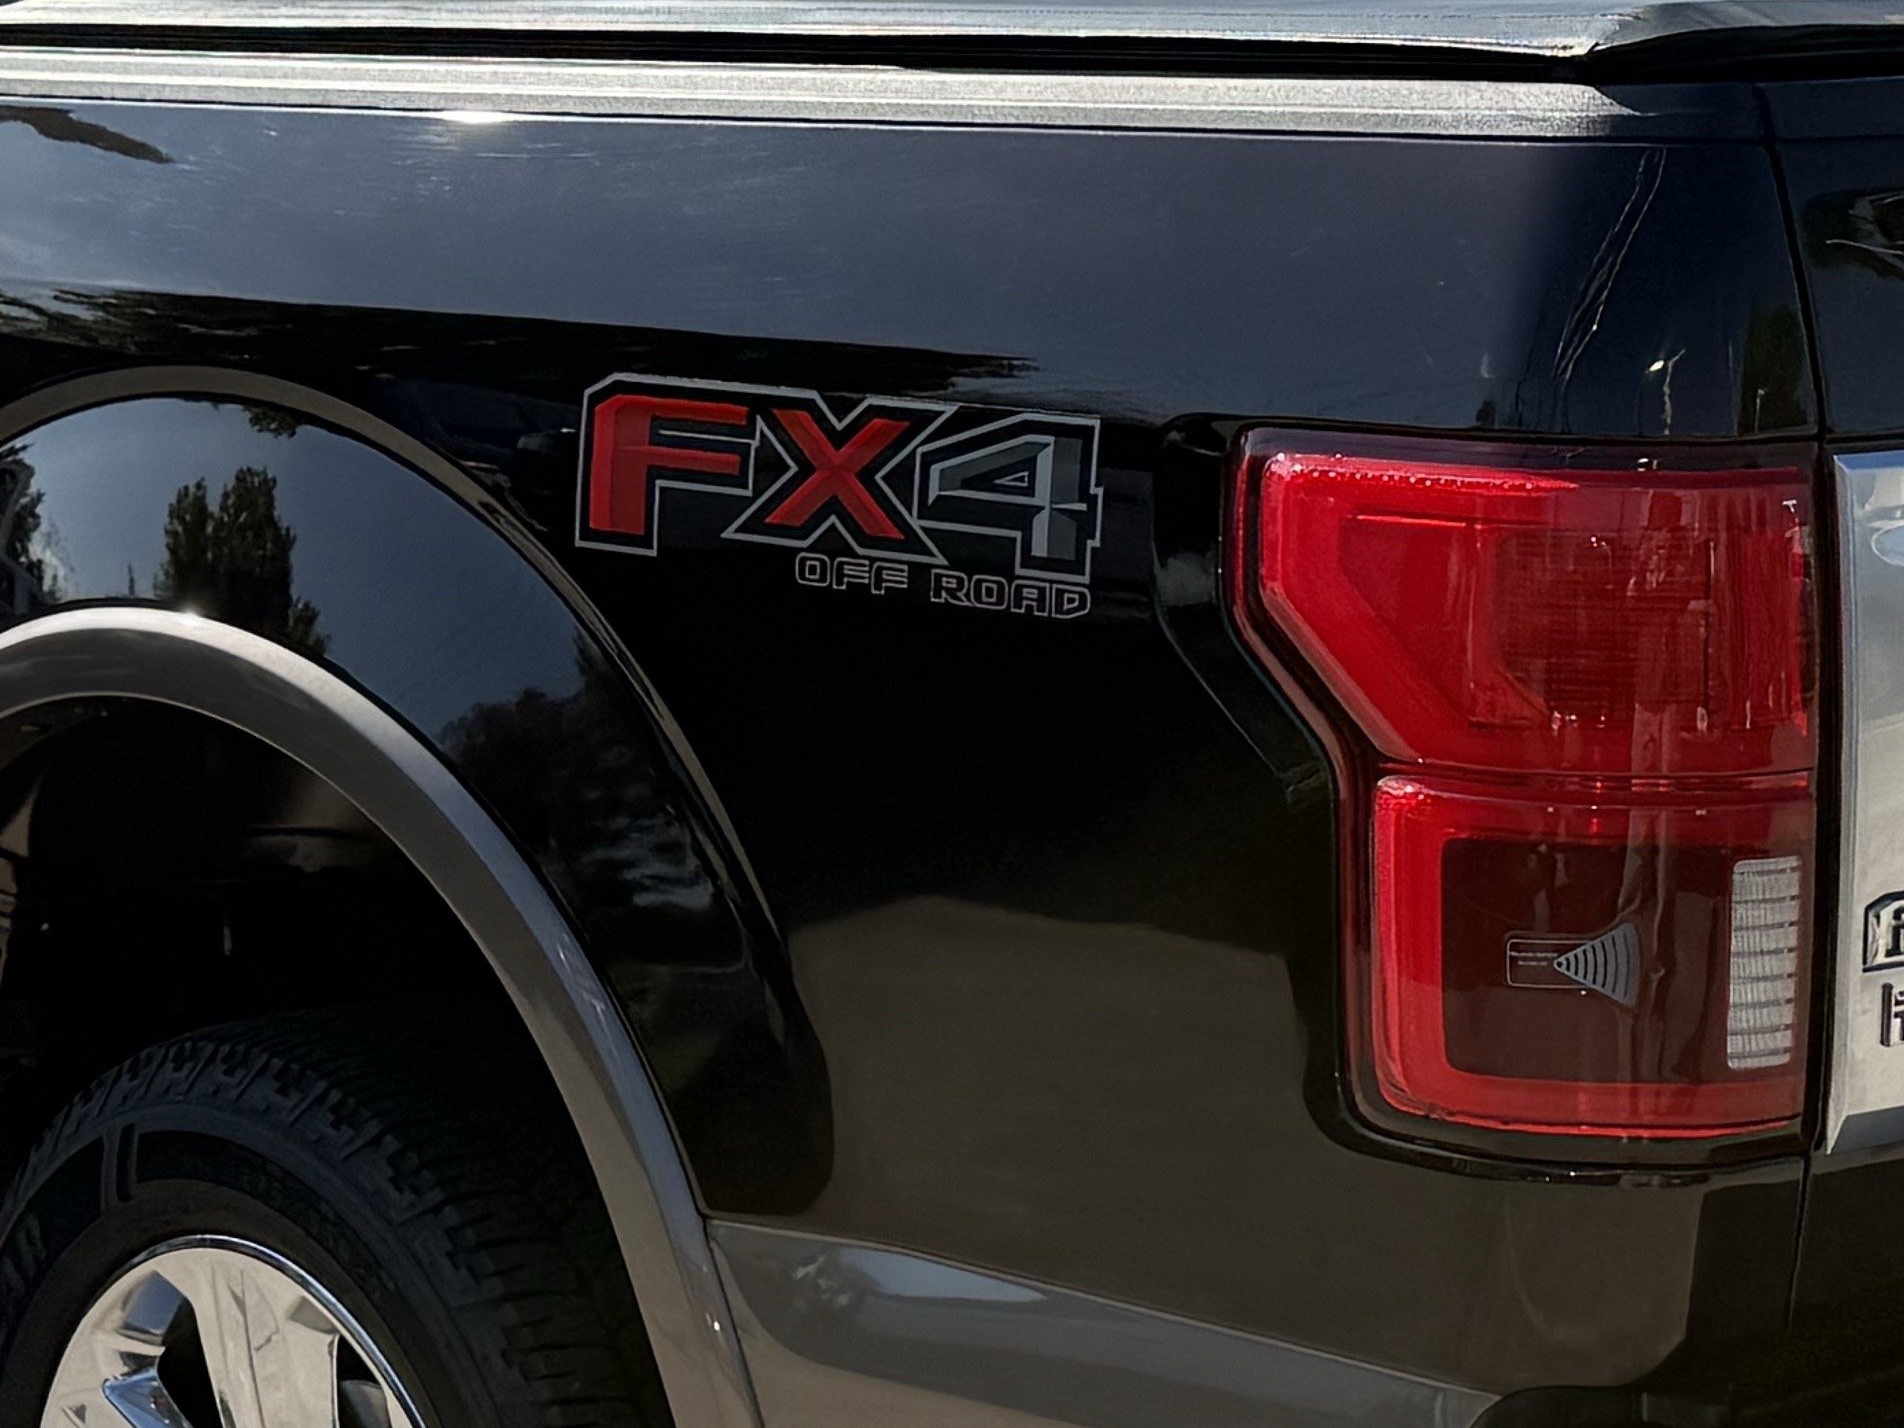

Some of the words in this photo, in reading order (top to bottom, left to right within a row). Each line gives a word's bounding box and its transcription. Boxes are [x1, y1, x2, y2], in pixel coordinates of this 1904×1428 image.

[578, 374, 1102, 582] FX4
[795, 552, 909, 595] OFF
[929, 569, 1091, 619] ROAD
